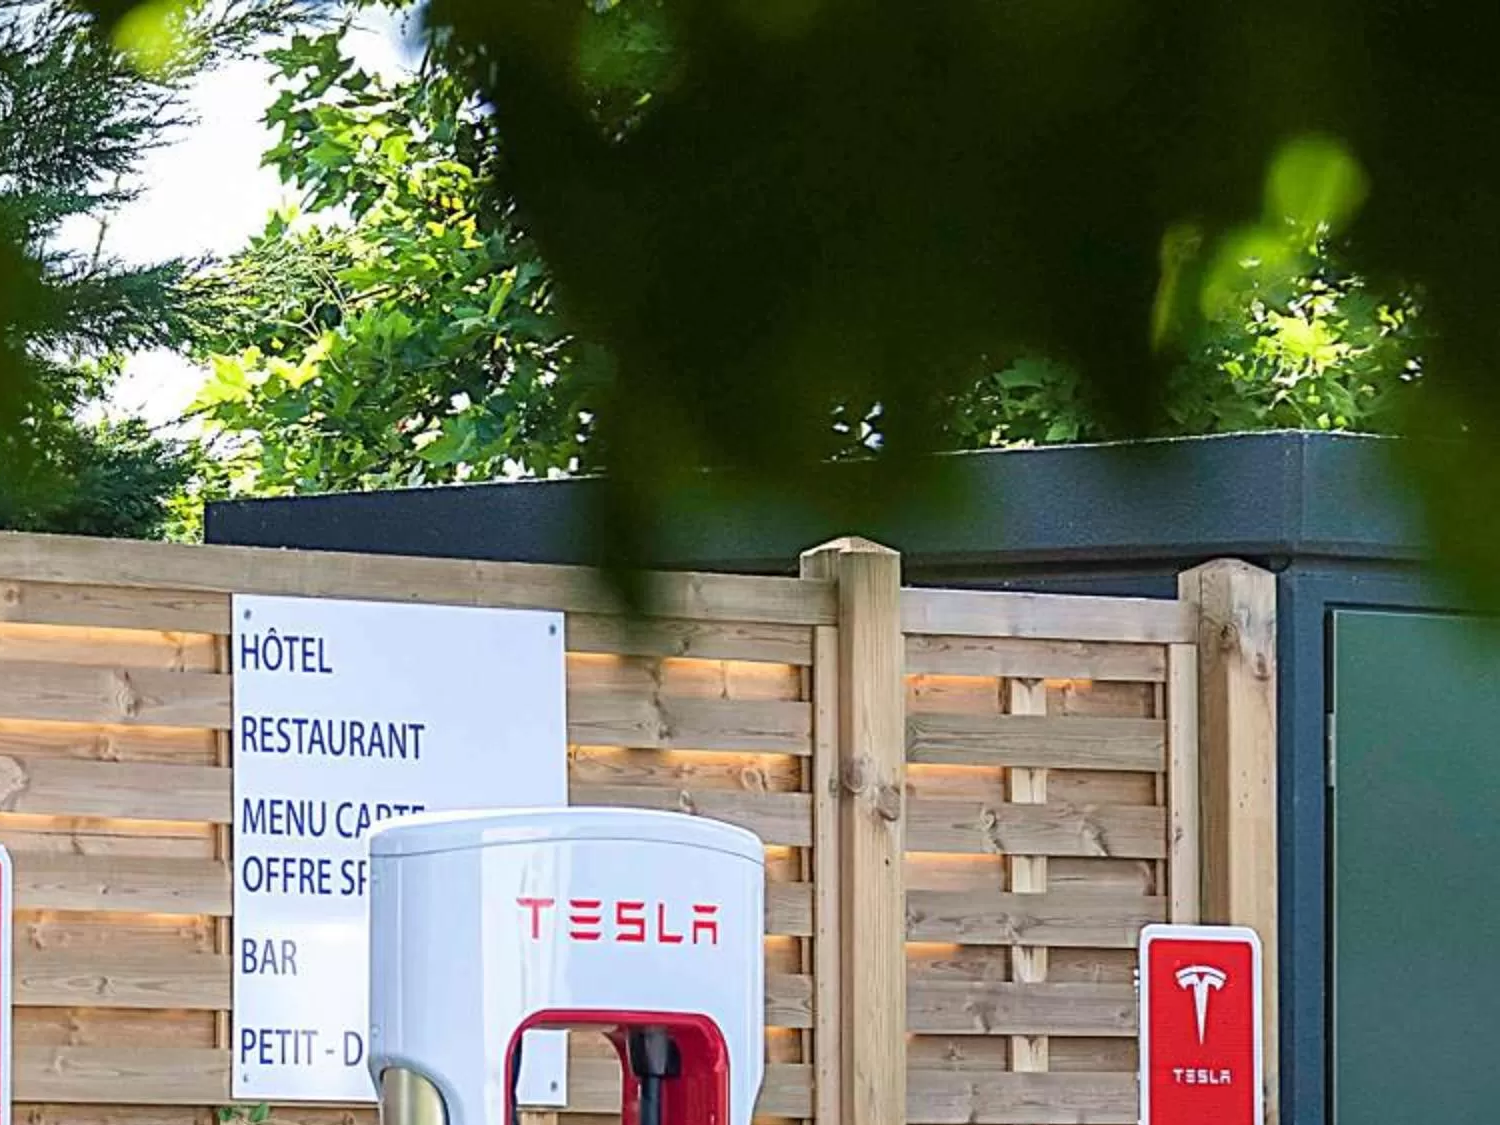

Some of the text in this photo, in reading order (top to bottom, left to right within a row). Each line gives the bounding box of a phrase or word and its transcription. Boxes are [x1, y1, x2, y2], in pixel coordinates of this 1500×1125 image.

[241, 627, 333, 674] HÔTEL
[241, 715, 425, 760] RESTAURANT
[242, 798, 327, 837] MENU
[242, 855, 332, 895] OFFRE
[516, 897, 718, 945] TESLA
[241, 937, 298, 976] BAR
[241, 1027, 318, 1066] PETIT
[1173, 1068, 1232, 1085] TESLA
